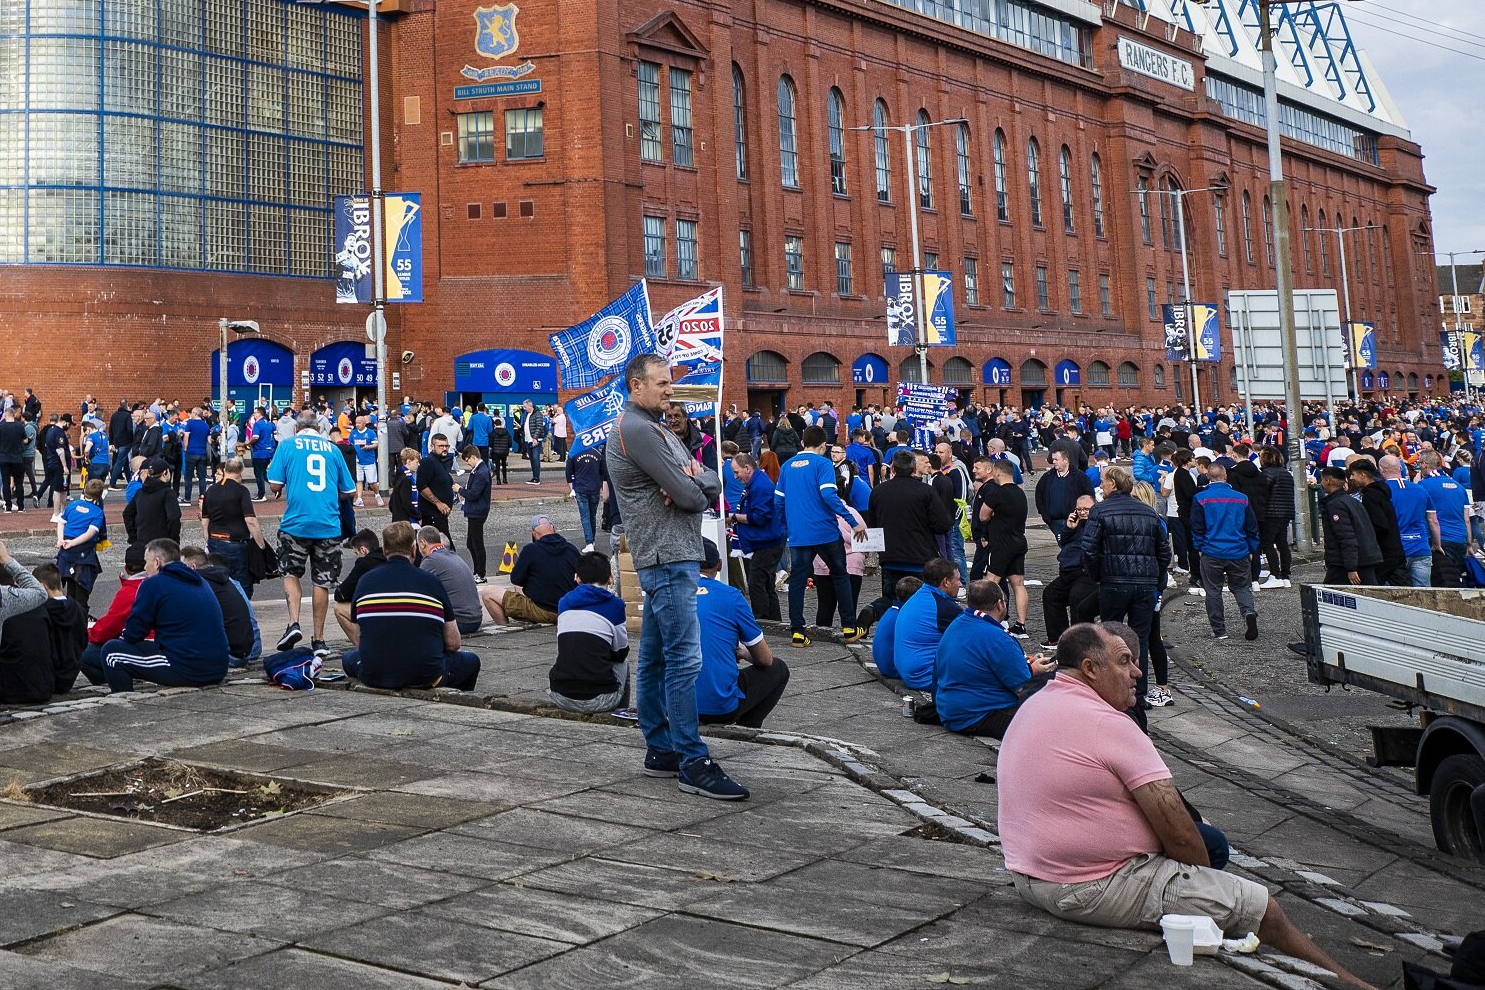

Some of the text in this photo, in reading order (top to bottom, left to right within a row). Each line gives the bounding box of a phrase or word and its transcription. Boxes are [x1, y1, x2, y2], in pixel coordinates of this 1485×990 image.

[1125, 42, 1191, 87] RANGERS F. C.
[457, 82, 538, 96] BILL STRUTH MAIN STAND
[352, 202, 372, 276] IBROX
[396, 259, 412, 271] 55
[898, 276, 915, 327] IBROX
[935, 316, 947, 326] 55
[1203, 337, 1214, 345] 55
[317, 373, 325, 382] 52
[327, 373, 334, 382] 51
[356, 373, 364, 382] 50
[365, 373, 373, 382] 49
[294, 438, 333, 453] STEIN
[306, 453, 327, 492] 9
